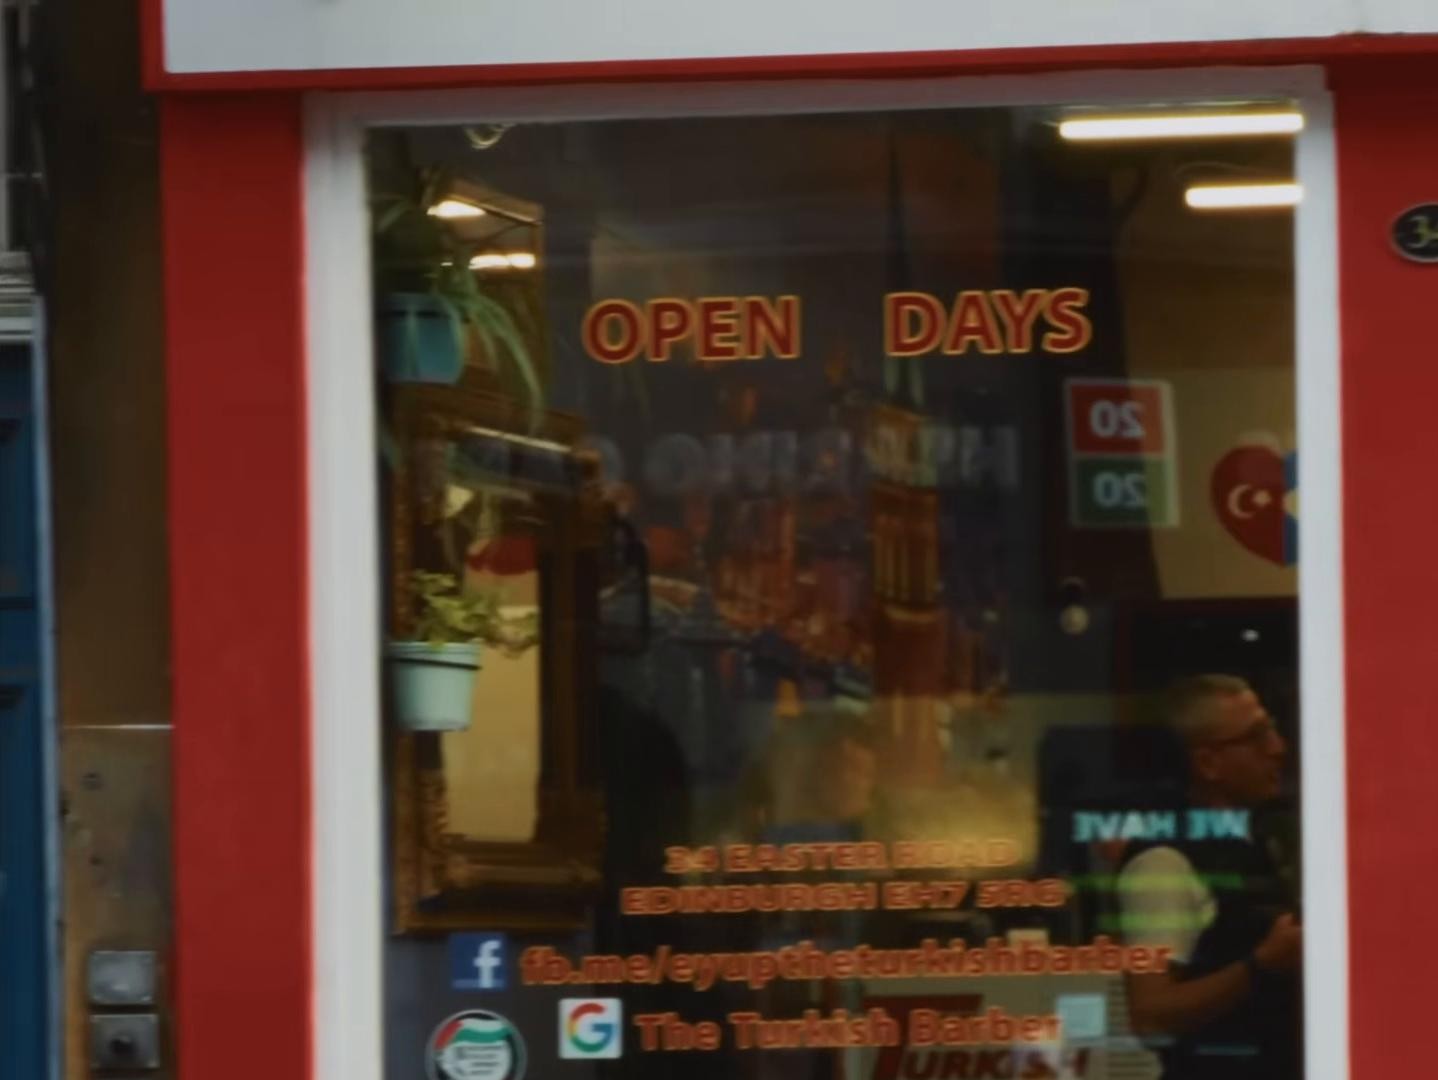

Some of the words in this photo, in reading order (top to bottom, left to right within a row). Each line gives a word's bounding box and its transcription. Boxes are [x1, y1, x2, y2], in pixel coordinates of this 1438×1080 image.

[582, 295, 800, 364] OPEN
[884, 287, 1092, 356] DAYS
[663, 845, 720, 875] 34
[725, 842, 887, 872] EASTER
[891, 838, 1020, 869] ROAD
[621, 884, 876, 915] EDINBURGH
[882, 881, 968, 910] EH7
[520, 937, 1172, 990] fb.me/eyuptheturkishbarber
[634, 1012, 720, 1051] The
[728, 1008, 900, 1050] Turkish
[907, 1006, 1064, 1046] Barber
